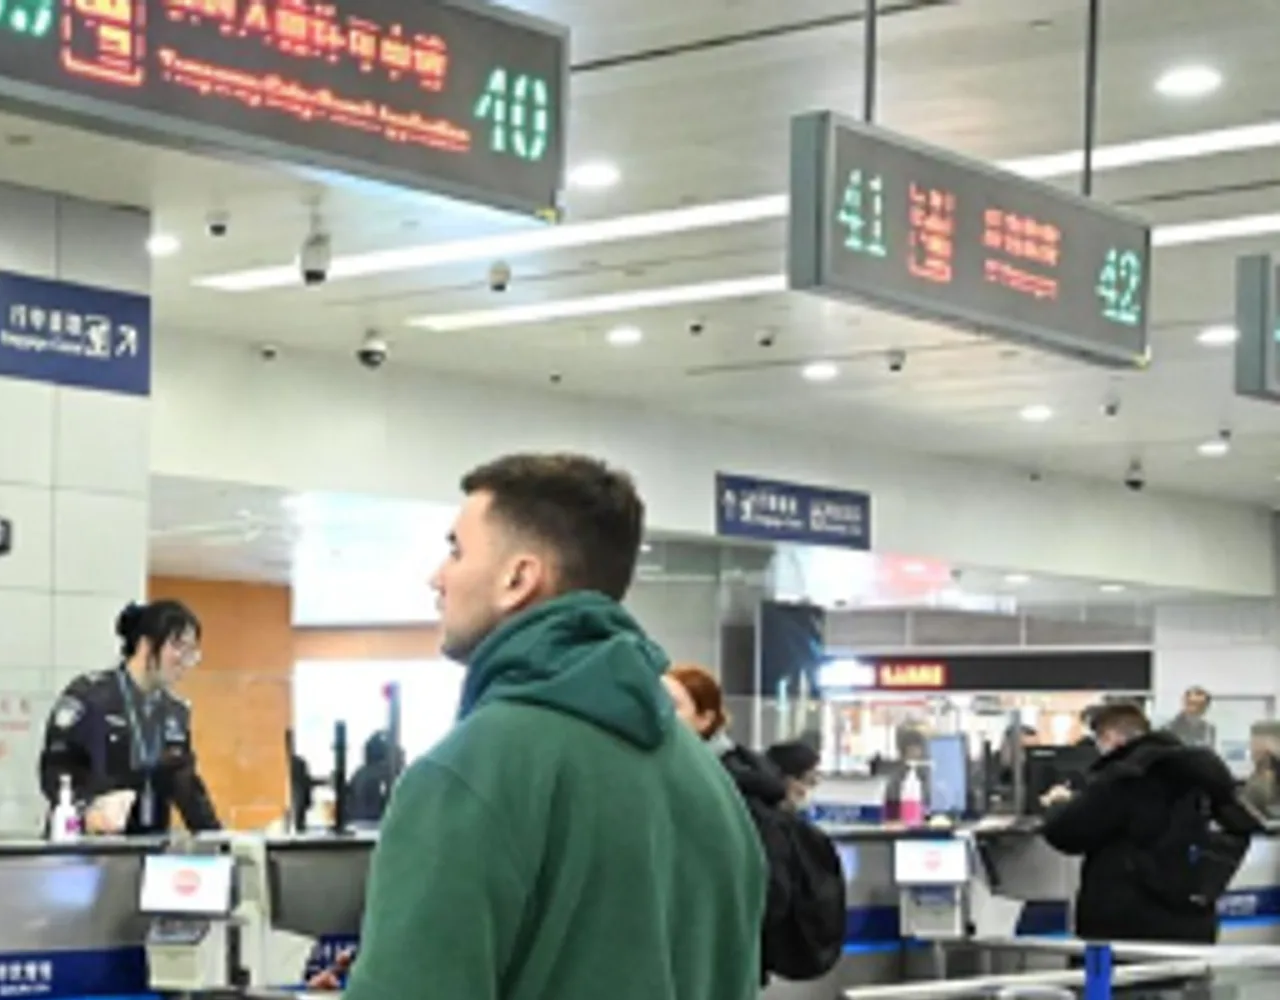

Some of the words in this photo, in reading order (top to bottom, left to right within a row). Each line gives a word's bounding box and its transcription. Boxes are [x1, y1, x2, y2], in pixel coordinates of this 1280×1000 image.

[474, 67, 548, 160] 40
[837, 167, 887, 258] 41
[1095, 247, 1141, 327] 42
